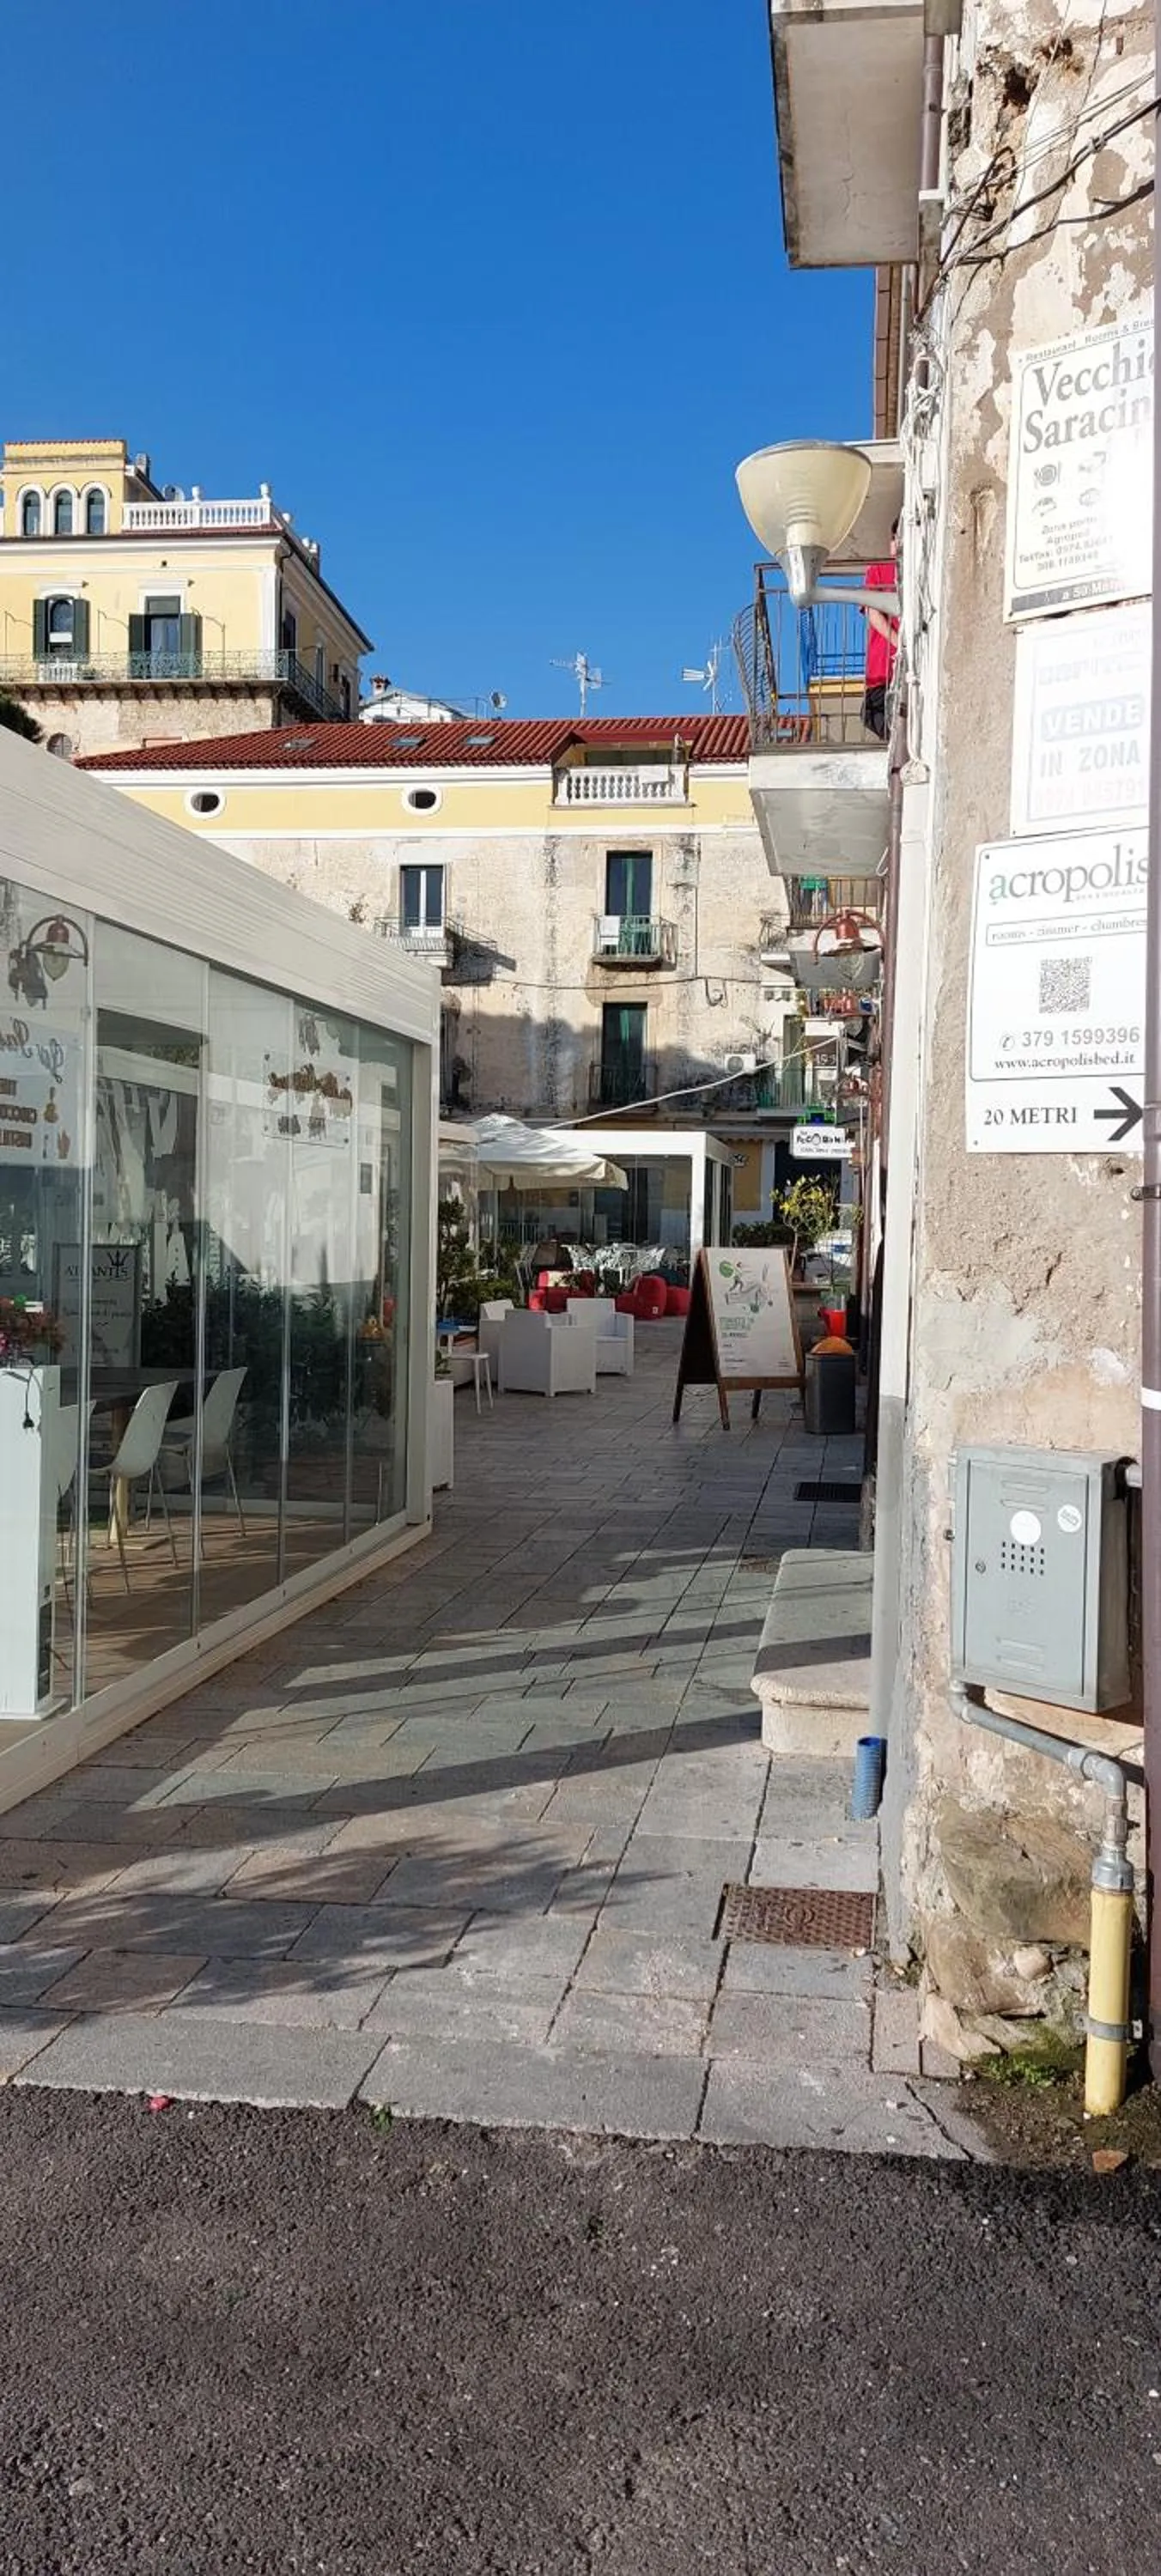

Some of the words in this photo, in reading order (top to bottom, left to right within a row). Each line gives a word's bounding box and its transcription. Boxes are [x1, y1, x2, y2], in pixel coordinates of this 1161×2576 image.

[1033, 338, 1154, 406] Vecchi
[1023, 388, 1152, 454] Saracin
[1046, 700, 1143, 735] VENDE
[1040, 750, 1062, 778] IN
[1079, 739, 1141, 772] ZONA
[988, 843, 1148, 903] acropolis
[991, 931, 1026, 942] rooms
[1022, 1030, 1054, 1047] 379
[1061, 1027, 1140, 1045] 1599396
[994, 1050, 1136, 1070] www.acropolisbed.it
[984, 1109, 1004, 1125] 20
[1010, 1107, 1078, 1125] METRI
